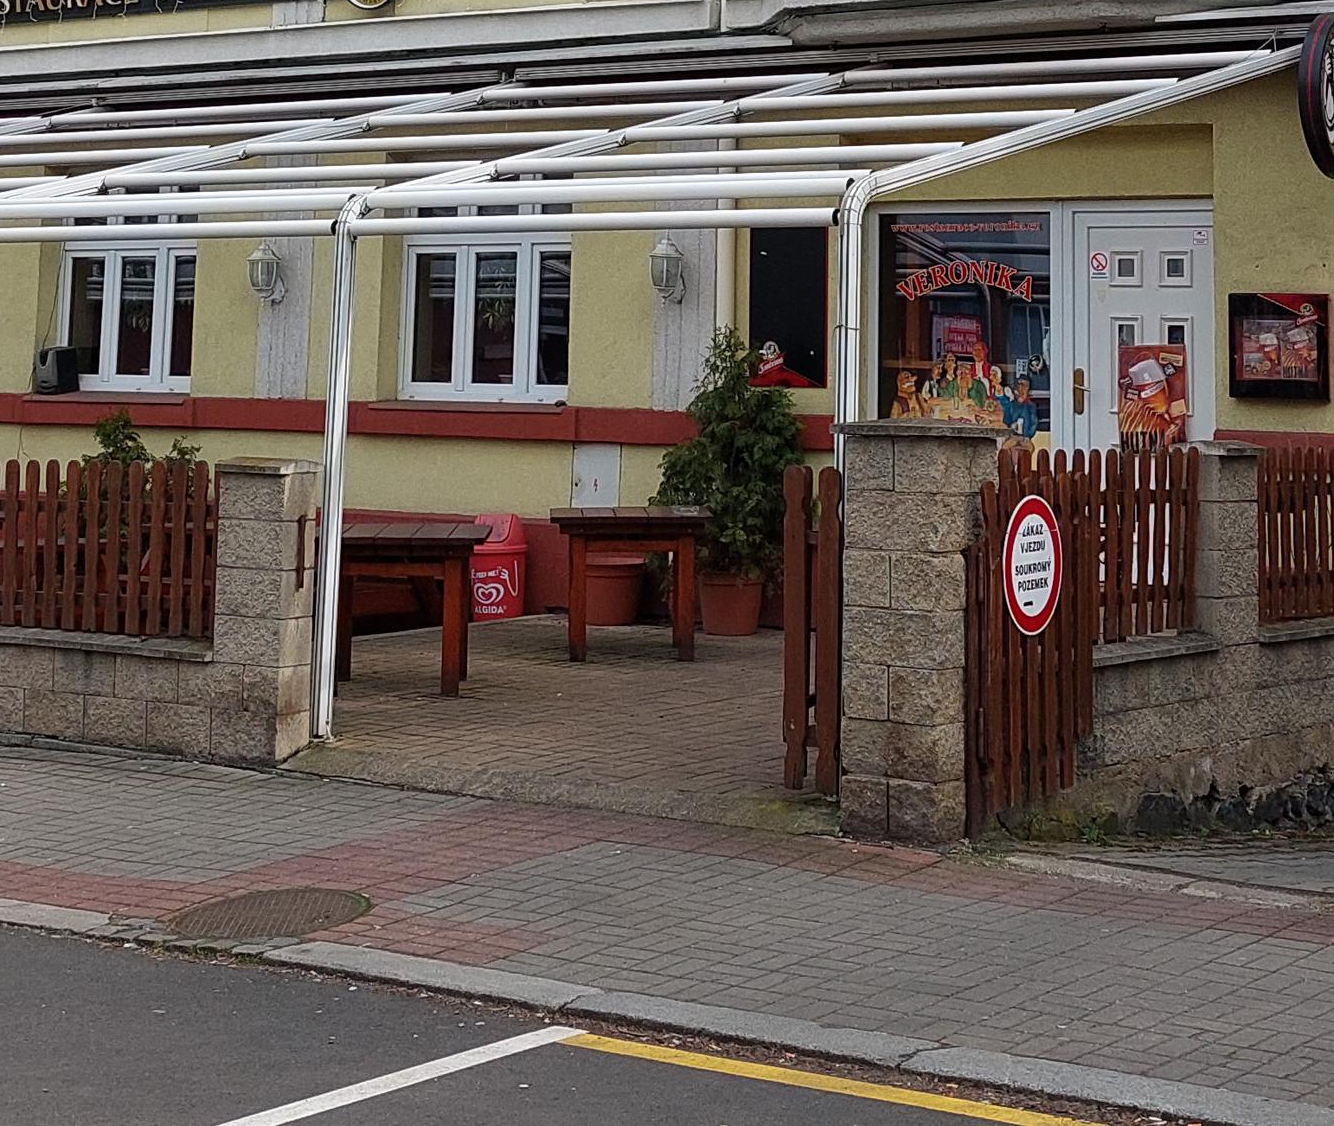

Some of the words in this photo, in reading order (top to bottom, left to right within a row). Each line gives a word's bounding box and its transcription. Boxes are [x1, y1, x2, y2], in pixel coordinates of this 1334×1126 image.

[896, 260, 1033, 303] VERONIKA
[1022, 522, 1044, 537] ZÁKAZ
[1020, 540, 1046, 554] VJEZDU
[1015, 556, 1052, 576] SOUKROMÝ
[1017, 577, 1049, 593] POZEMEK
